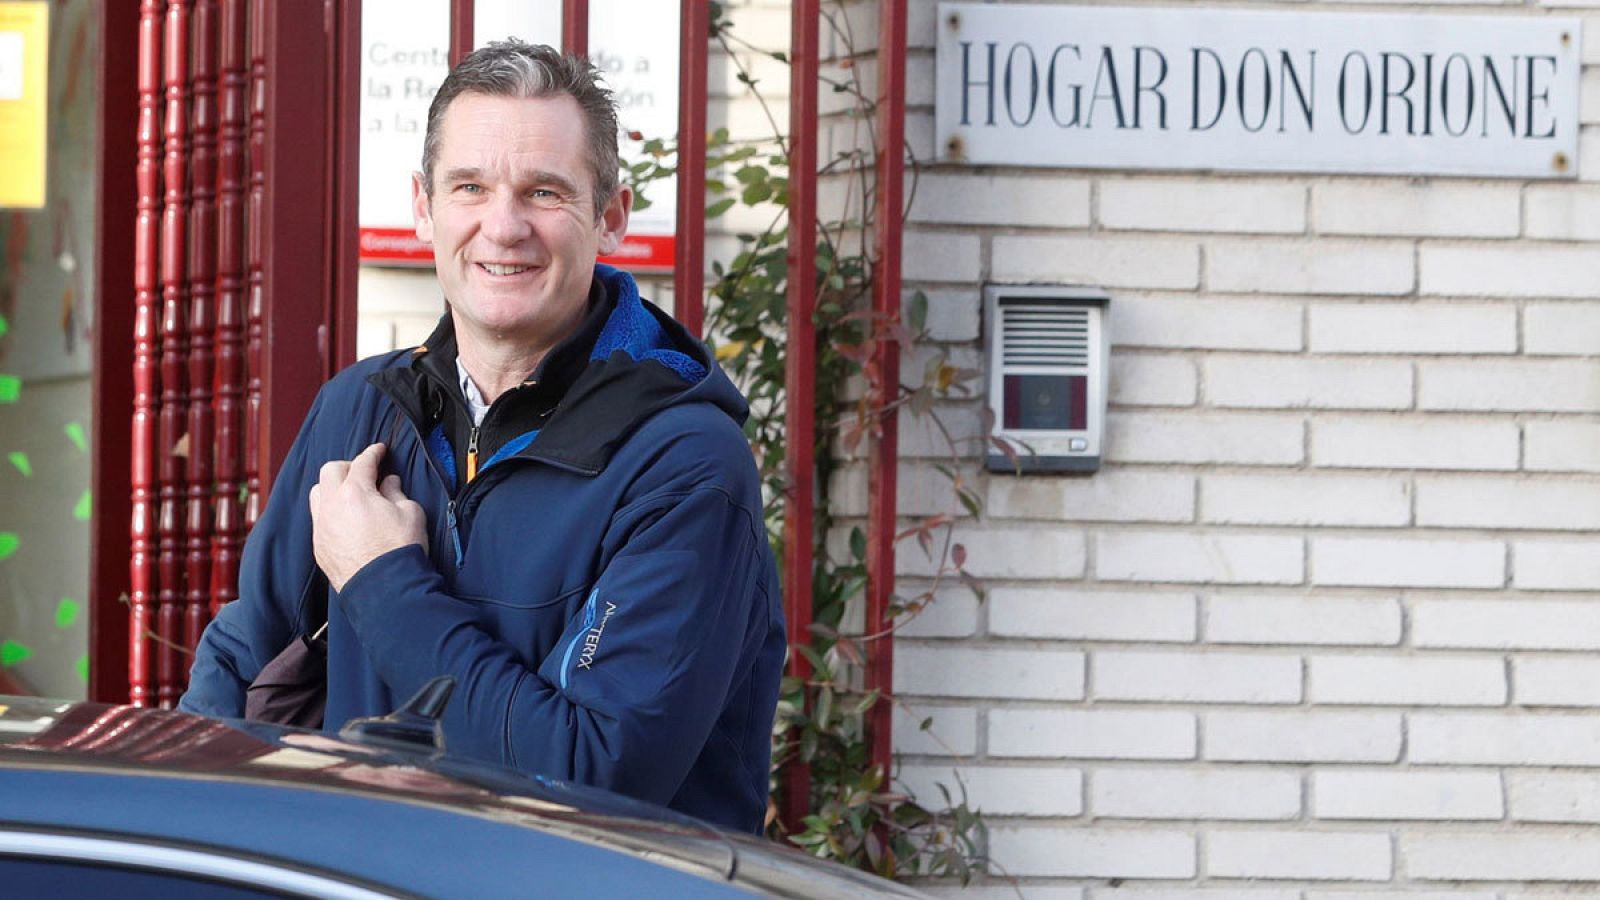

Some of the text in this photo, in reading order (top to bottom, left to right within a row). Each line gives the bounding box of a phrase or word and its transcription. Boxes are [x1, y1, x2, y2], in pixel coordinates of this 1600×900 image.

[959, 41, 1557, 139] HOGAR DON ORIONE
